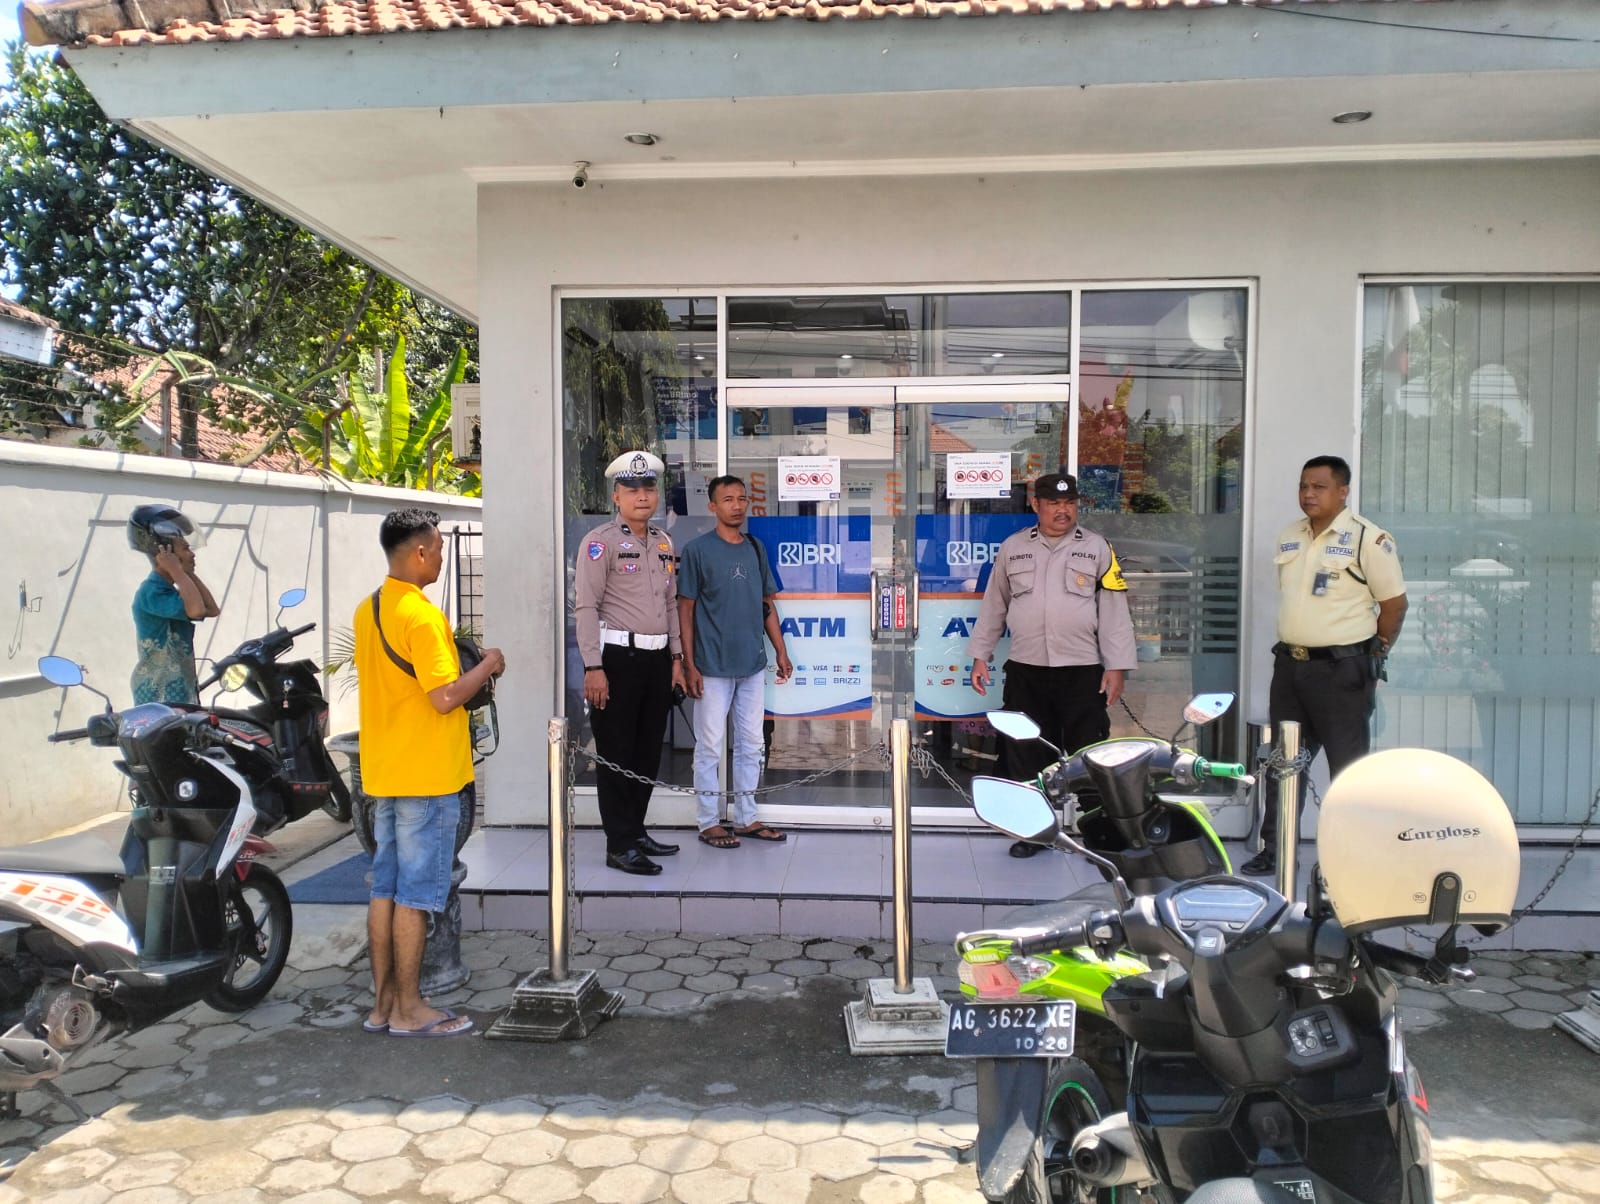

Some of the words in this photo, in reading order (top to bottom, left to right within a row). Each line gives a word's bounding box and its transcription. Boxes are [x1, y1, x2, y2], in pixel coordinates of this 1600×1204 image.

[803, 543, 842, 565] BRI
[972, 542, 1001, 564] BR
[1071, 551, 1097, 561] POLRI
[780, 617, 846, 638] ATM
[833, 677, 861, 686] BRIZZI
[1397, 826, 1481, 842] Cargloss
[951, 1008, 976, 1031] AG
[987, 1007, 1037, 1029] 3622
[1042, 1005, 1072, 1029] XE
